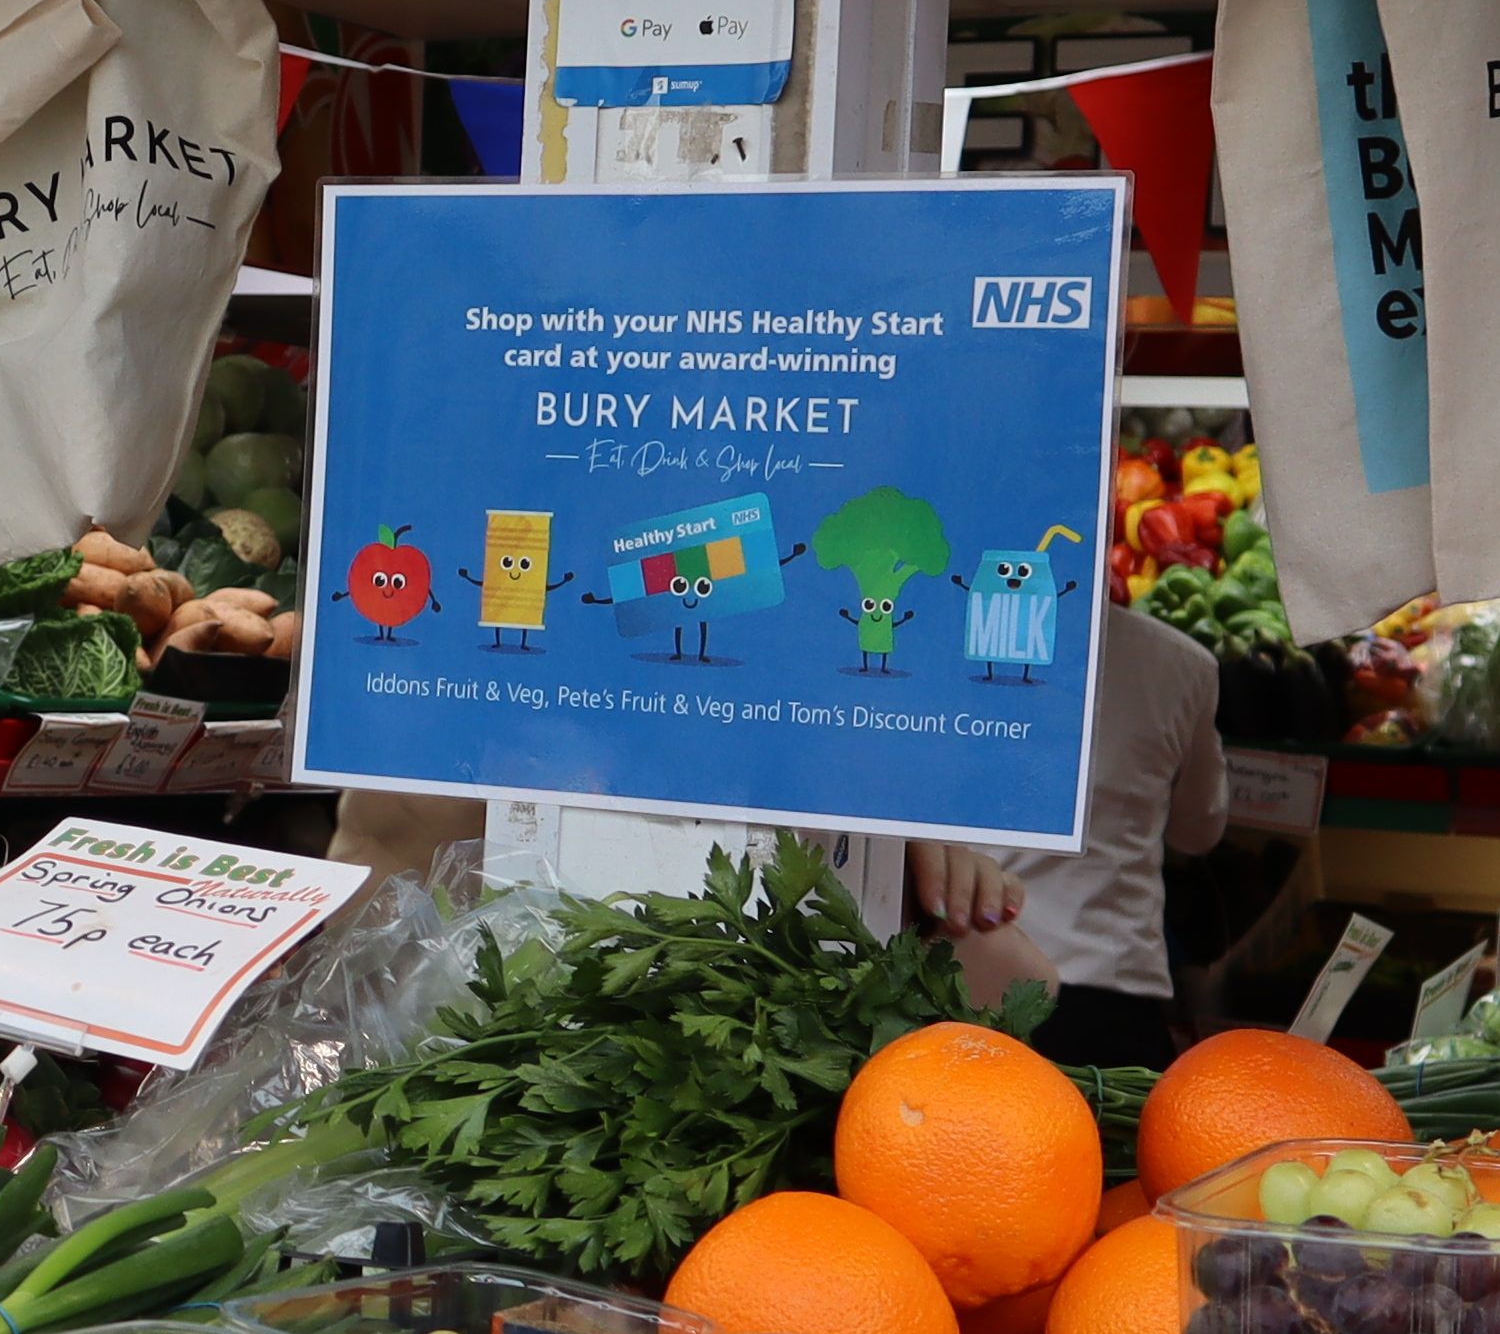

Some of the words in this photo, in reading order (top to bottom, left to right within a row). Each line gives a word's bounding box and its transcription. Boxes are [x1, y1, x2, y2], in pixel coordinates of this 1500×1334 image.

[642, 19, 673, 41] Pay
[717, 16, 749, 40] Pay
[465, 307, 535, 338] Shop
[541, 307, 606, 334] with
[612, 312, 679, 339] your
[686, 310, 744, 335] NHS
[751, 309, 863, 343] Healthy
[870, 310, 945, 337] Start
[981, 280, 1089, 326] NHS
[503, 345, 565, 370] card
[570, 348, 600, 370] at
[606, 349, 673, 376] your
[679, 345, 897, 380] award-winning
[536, 391, 652, 429] BURY
[670, 394, 860, 435] MARKET
[585, 437, 629, 473] Eat,
[631, 441, 688, 477] Drink
[695, 449, 709, 467] &
[716, 444, 760, 482] Shop
[765, 444, 803, 481] Local
[612, 528, 675, 555] Healthy
[676, 517, 717, 540] Start
[733, 508, 760, 525] NHS
[969, 591, 1052, 663] MILK
[365, 672, 431, 698] Iddons
[435, 677, 480, 701] Fruit
[485, 681, 502, 703] &
[505, 682, 551, 711] Veg,
[557, 685, 615, 712] Pete's
[620, 689, 667, 714] Fruit
[672, 693, 690, 716] &
[697, 694, 736, 725] Veg
[741, 698, 782, 722] and
[787, 698, 846, 726] Tom's
[852, 703, 947, 734] Discount
[954, 712, 1033, 741] Corner
[48, 827, 157, 865] Fresh
[158, 845, 202, 872] is
[199, 853, 298, 890] Best
[20, 859, 138, 904] Spring
[155, 886, 279, 924] Onions
[187, 878, 332, 909] Naturally
[10, 898, 108, 951] 75p
[128, 934, 223, 968] each
